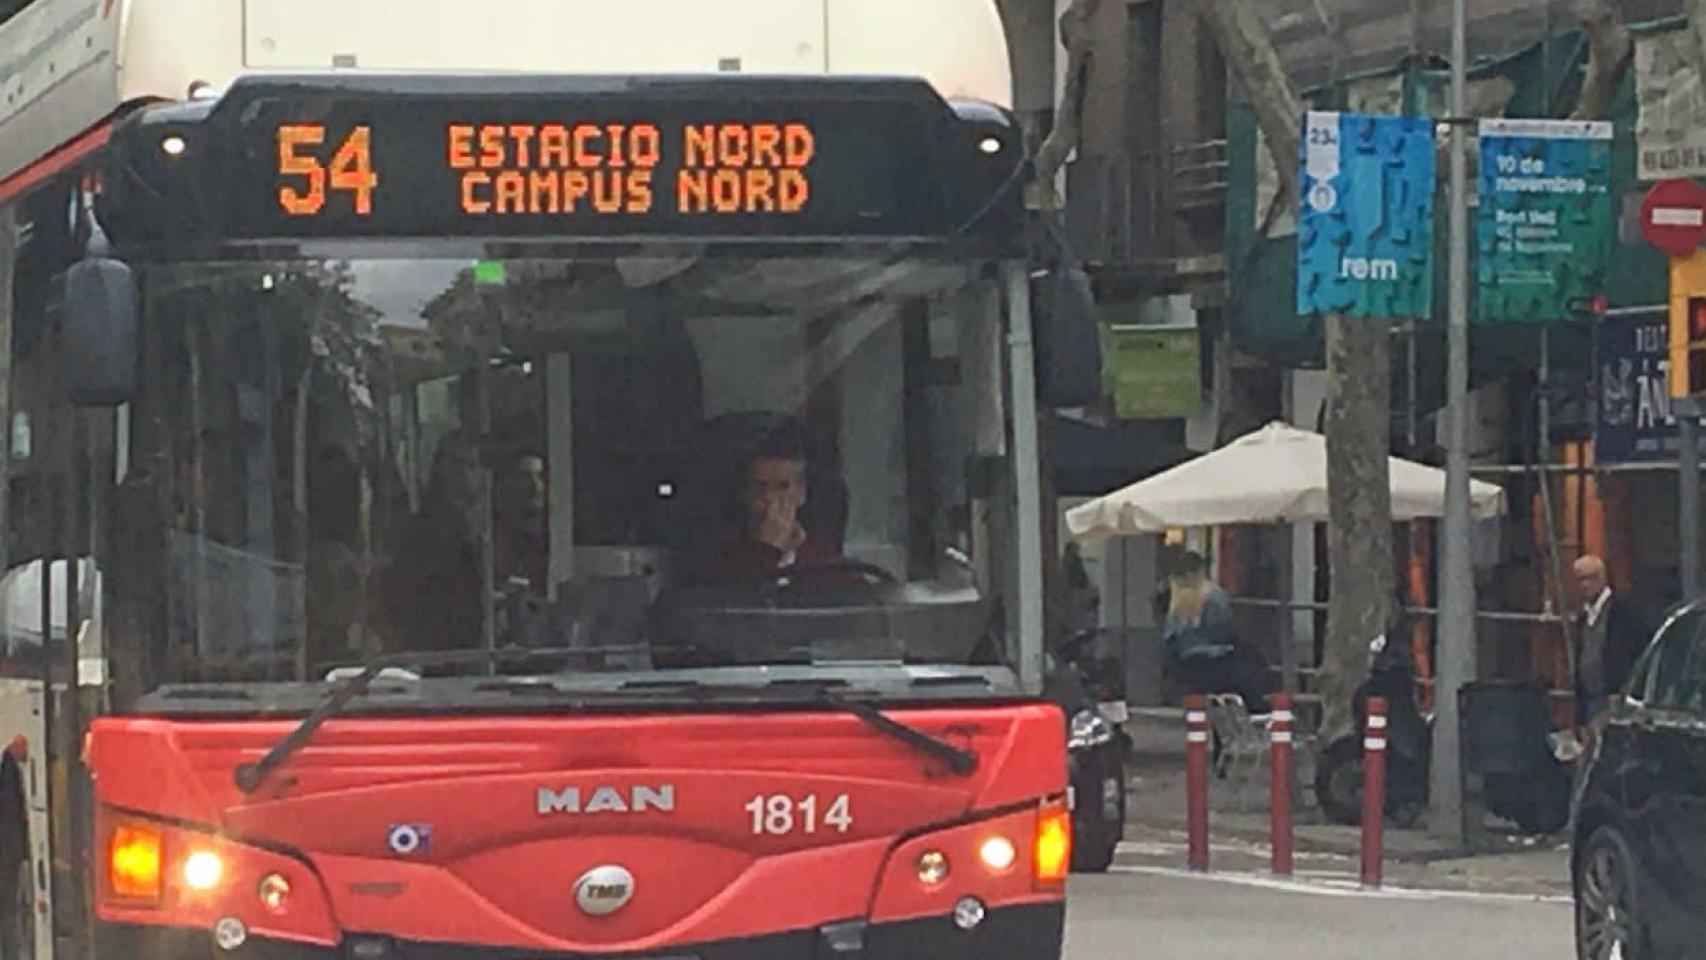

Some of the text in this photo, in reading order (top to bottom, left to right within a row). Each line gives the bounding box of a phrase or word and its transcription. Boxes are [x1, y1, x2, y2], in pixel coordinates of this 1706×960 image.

[448, 124, 815, 168] ESTACIO NORD
[278, 124, 378, 215] 54
[461, 168, 809, 214] CAMPUS NORD
[1341, 257, 1399, 280] rem
[537, 784, 675, 815] MAN
[745, 793, 853, 835] 1814
